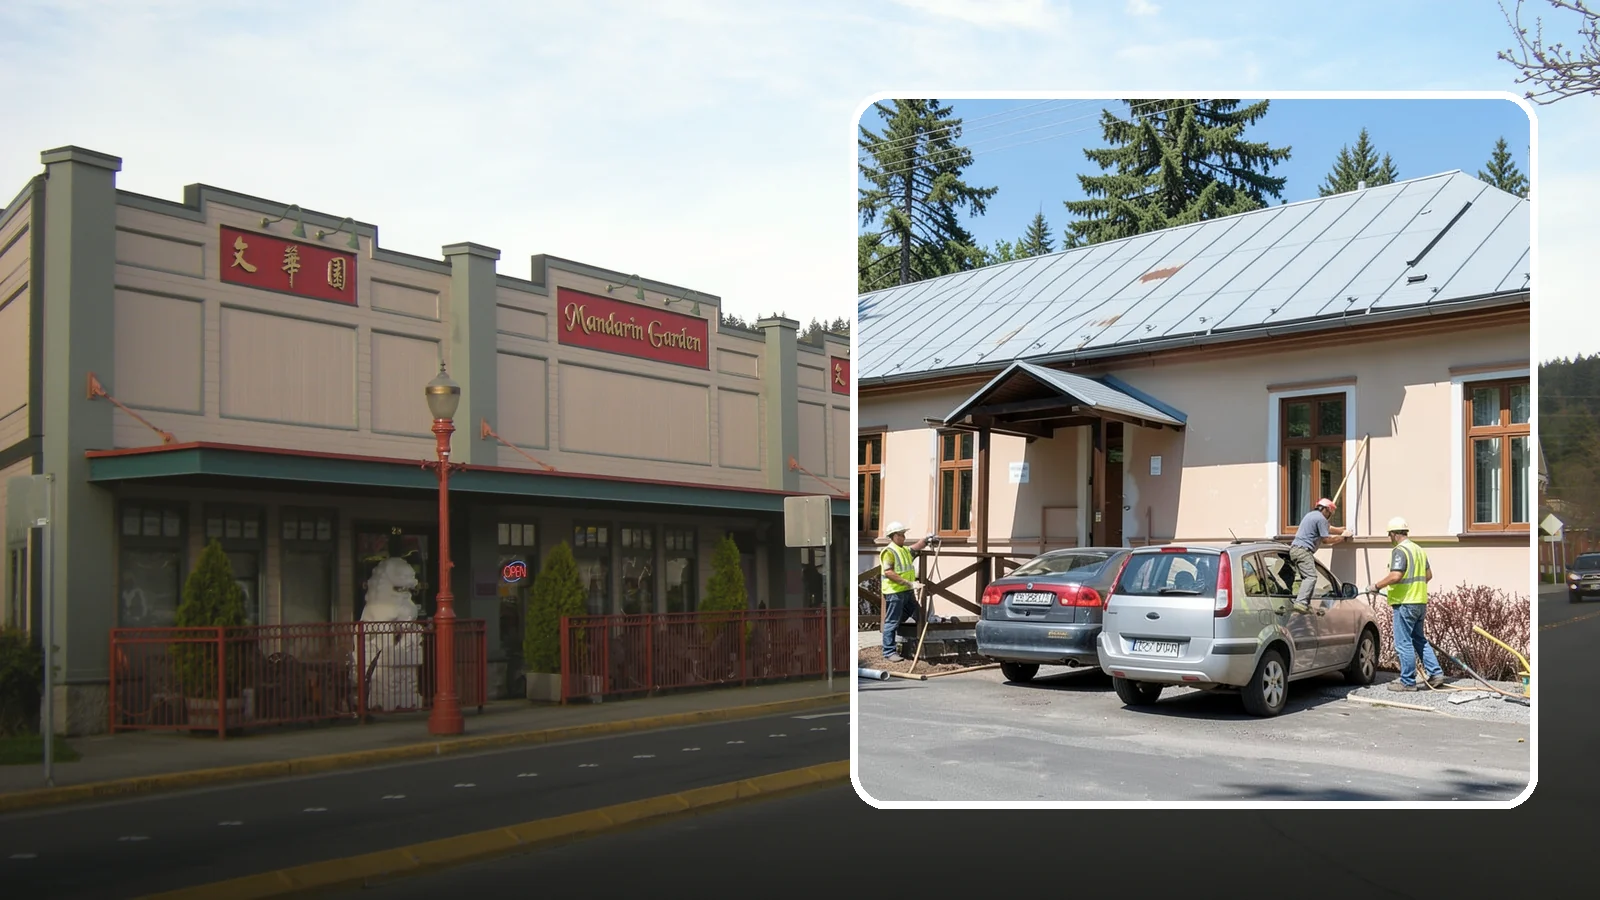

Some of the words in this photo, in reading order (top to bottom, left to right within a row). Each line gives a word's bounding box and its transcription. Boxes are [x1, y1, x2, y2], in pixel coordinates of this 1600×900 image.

[231, 235, 346, 291] 文華園
[564, 302, 644, 341] Mandarin
[648, 320, 702, 352] Garden
[503, 565, 527, 578] OPEN
